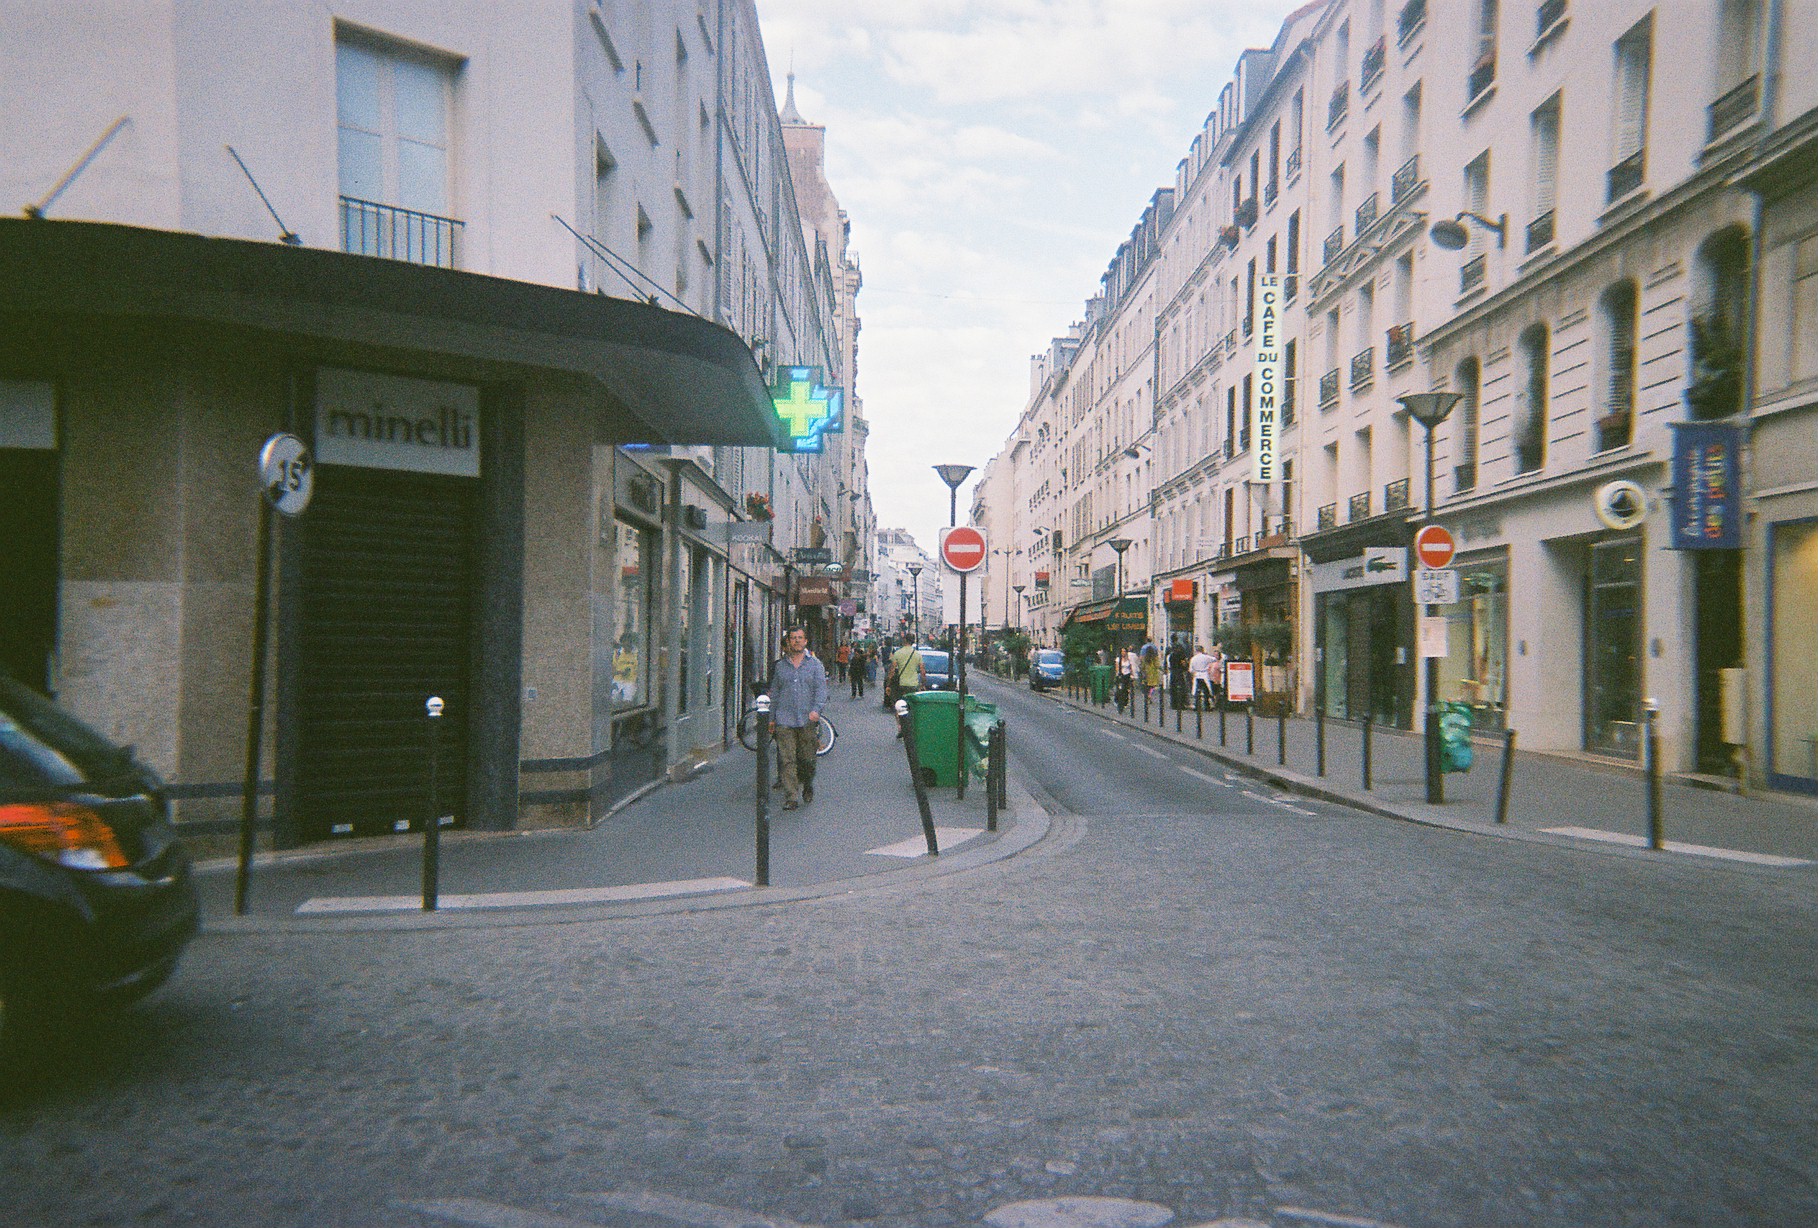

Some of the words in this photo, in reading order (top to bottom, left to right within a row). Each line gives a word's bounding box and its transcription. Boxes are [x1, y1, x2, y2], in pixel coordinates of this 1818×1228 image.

[1261, 276, 1278, 287] LE
[1262, 291, 1275, 348] CAFE
[1258, 352, 1278, 363] DU
[326, 401, 471, 449] minelli
[1259, 367, 1274, 480] COMMERCE
[278, 459, 302, 491] 15
